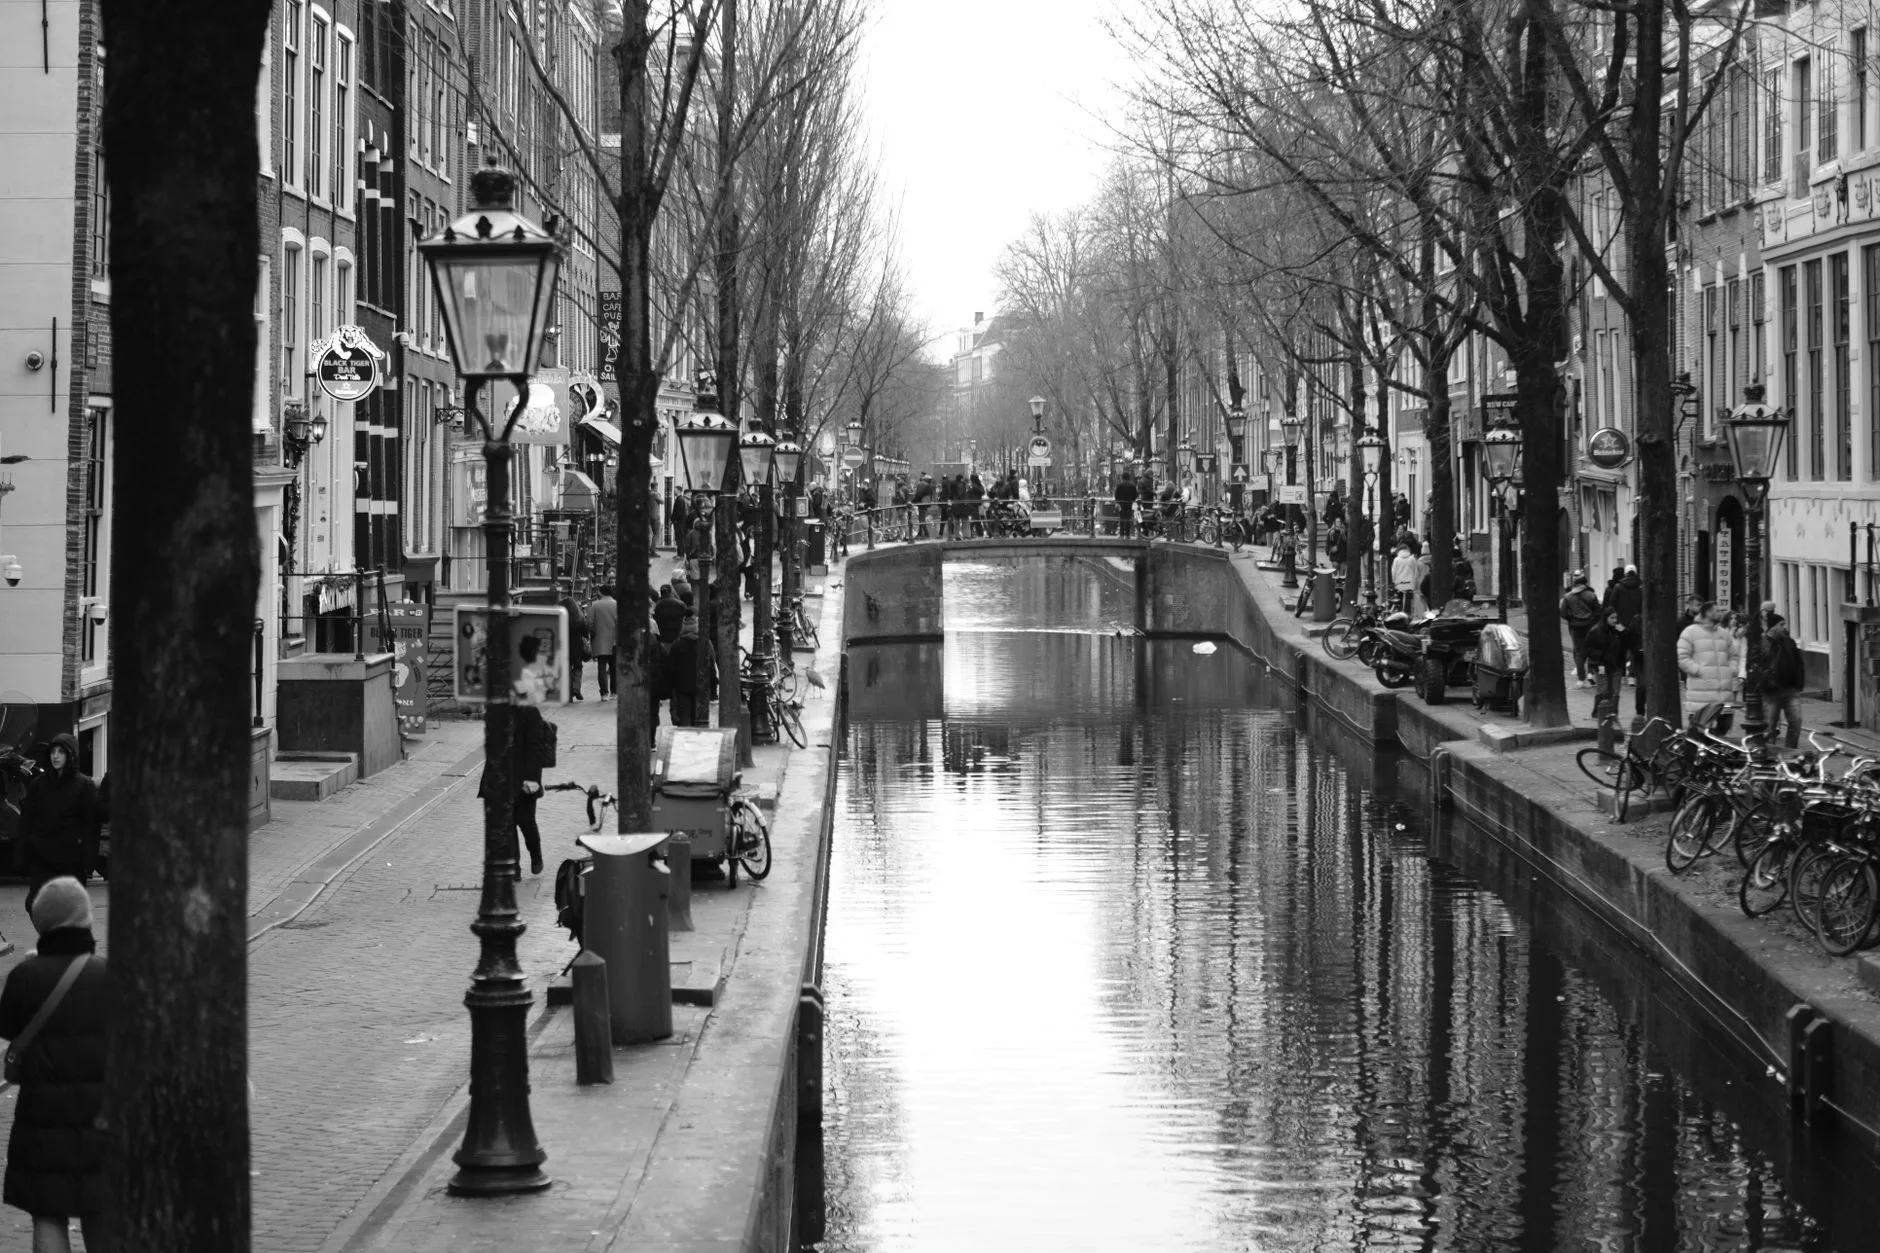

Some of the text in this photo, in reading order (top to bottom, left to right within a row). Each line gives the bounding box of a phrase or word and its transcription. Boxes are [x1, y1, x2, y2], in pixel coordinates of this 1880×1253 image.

[603, 312, 622, 321] PUB
[337, 366, 356, 374] BAR
[400, 627, 423, 639] TIGER
